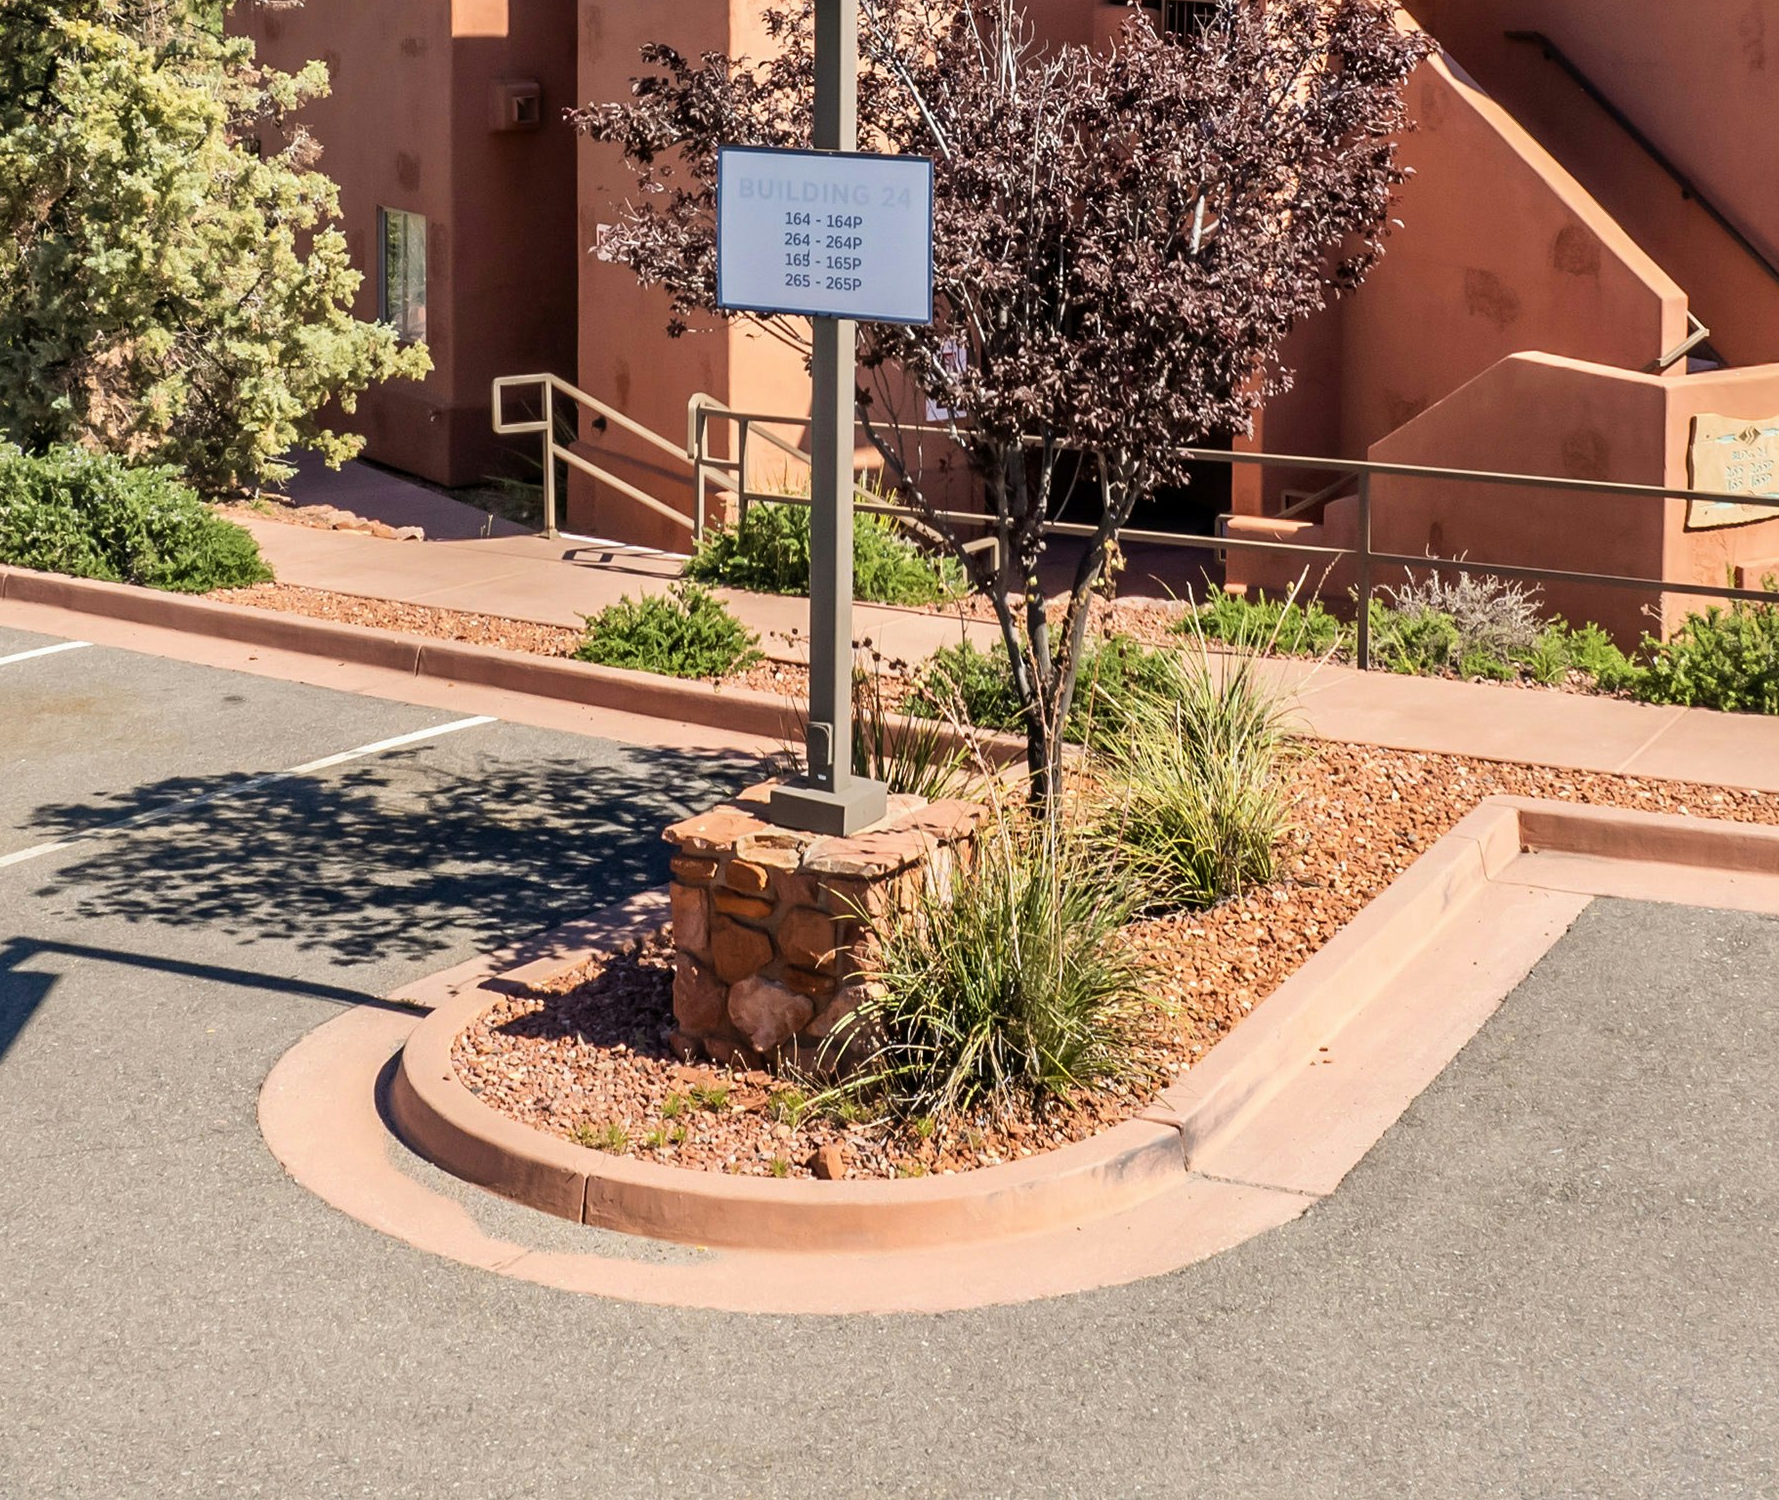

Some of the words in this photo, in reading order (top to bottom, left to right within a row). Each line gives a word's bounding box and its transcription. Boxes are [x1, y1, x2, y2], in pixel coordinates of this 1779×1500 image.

[739, 177, 870, 207] BUILDING
[881, 184, 912, 211] 24
[785, 211, 811, 226] 164
[826, 214, 863, 229] 164P
[784, 232, 811, 246] 264
[825, 235, 862, 250] 264P
[785, 252, 811, 267] 165
[826, 256, 862, 270] 165P
[785, 273, 811, 288] 265
[825, 276, 862, 291] 265P
